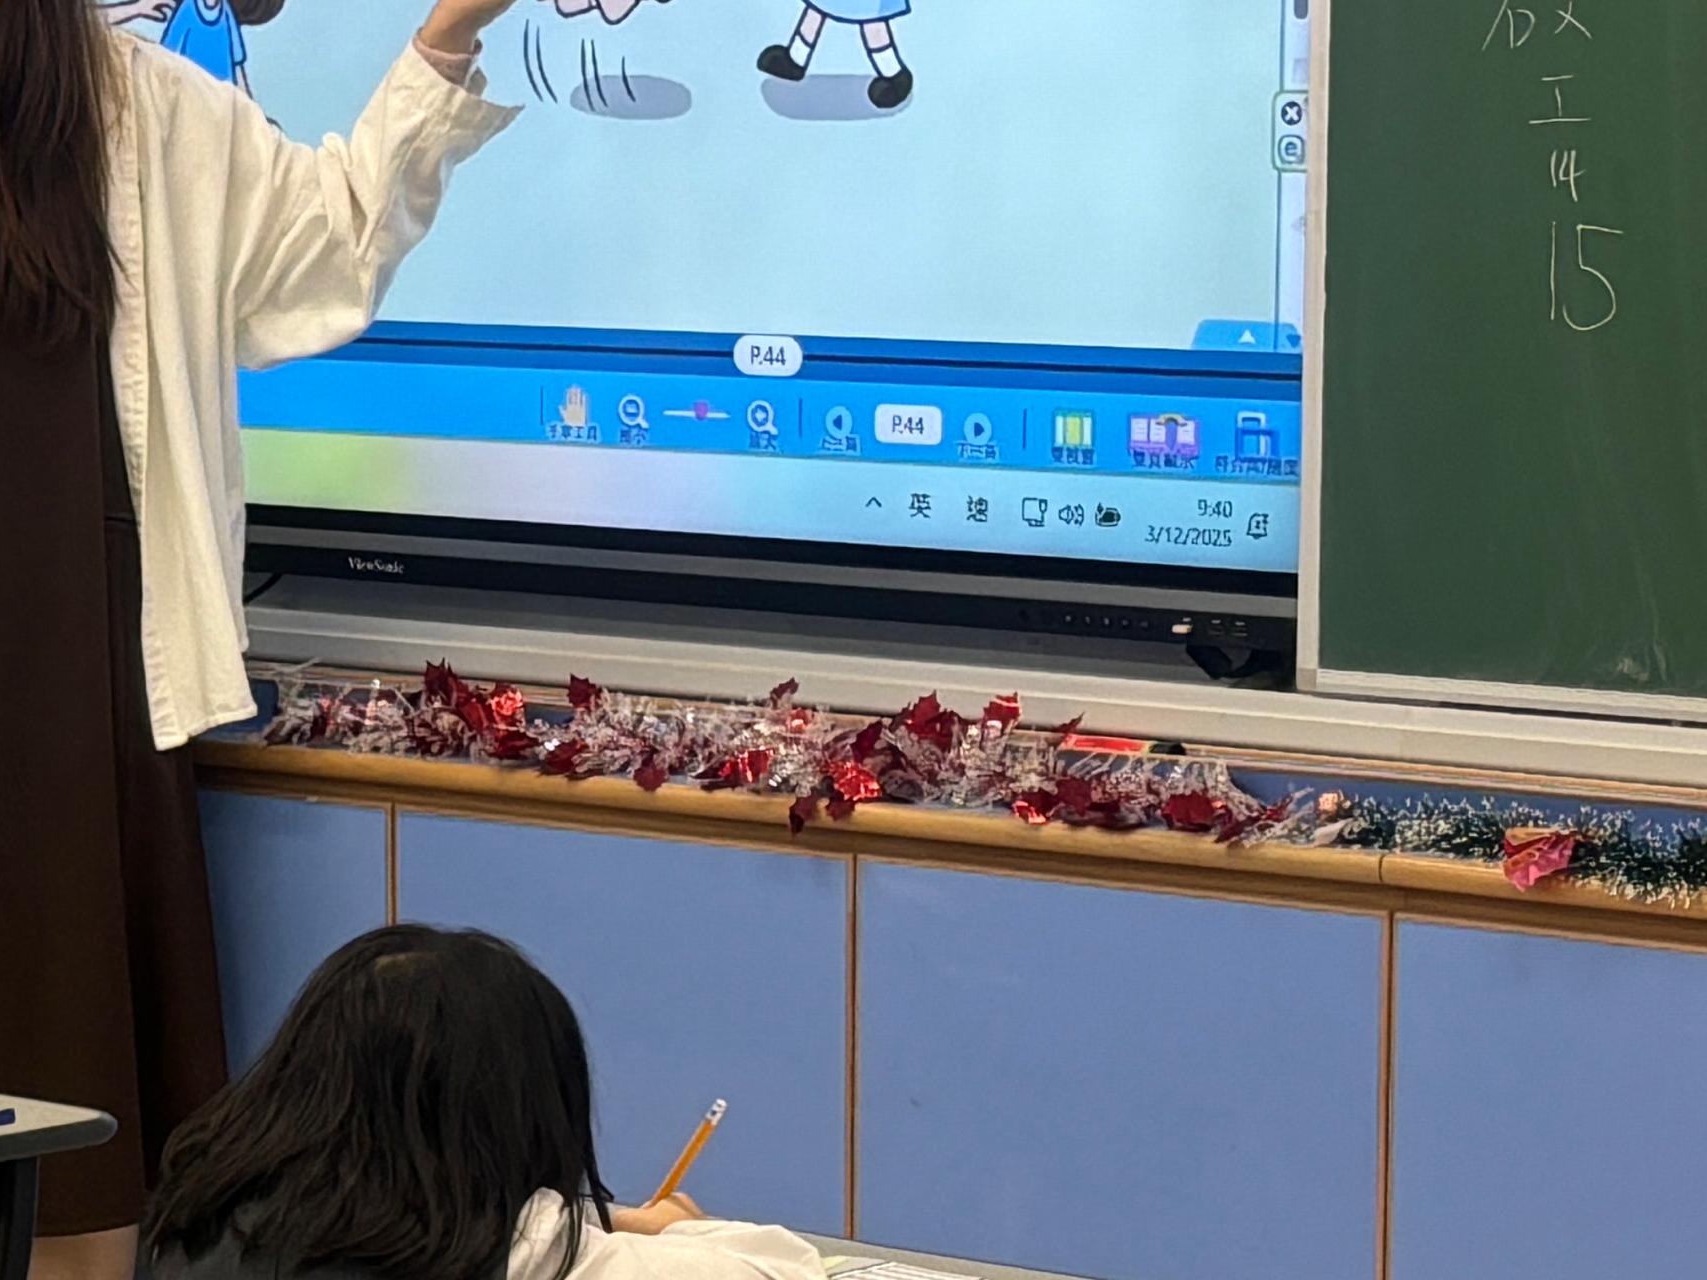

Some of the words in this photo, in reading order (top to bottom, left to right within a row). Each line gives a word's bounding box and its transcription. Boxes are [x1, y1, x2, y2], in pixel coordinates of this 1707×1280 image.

[1551, 221, 1623, 330] 15
[750, 346, 786, 366] P.44
[891, 416, 925, 435] P.44
[909, 493, 931, 518] 英
[1198, 499, 1233, 518] 9:40
